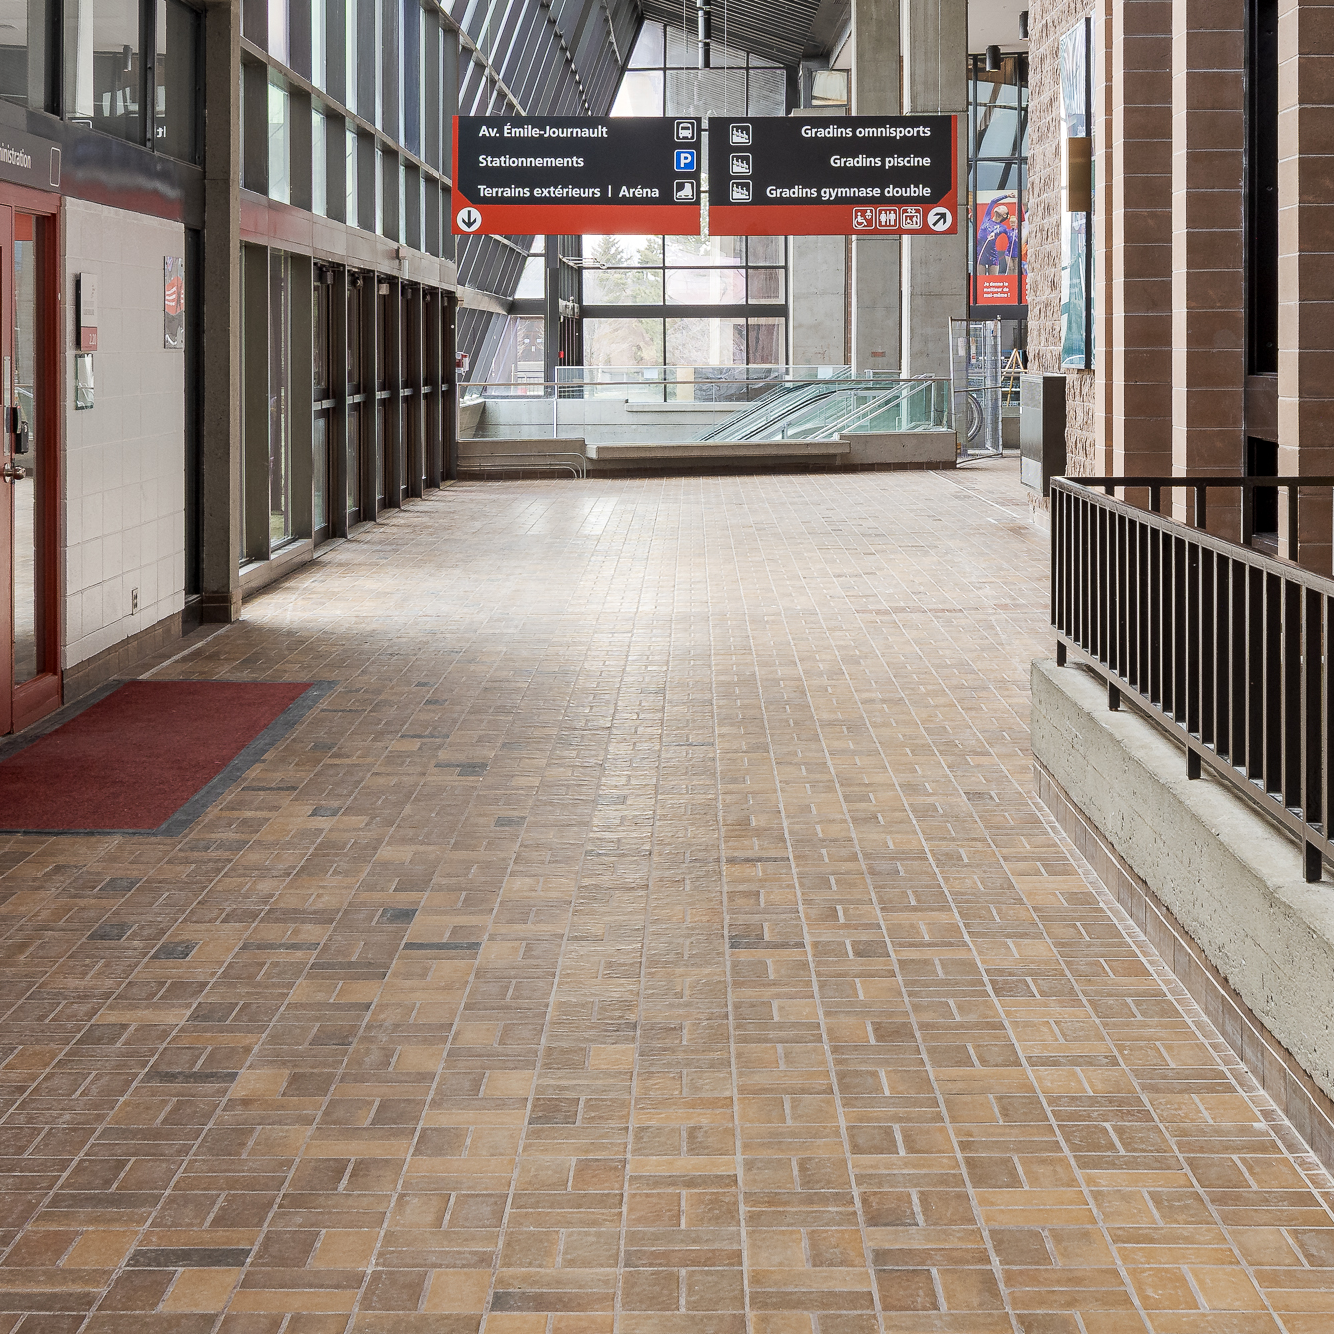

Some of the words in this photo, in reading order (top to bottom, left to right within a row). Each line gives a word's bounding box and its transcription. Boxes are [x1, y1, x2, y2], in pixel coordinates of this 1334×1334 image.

[478, 125, 500, 137] Av.
[503, 123, 608, 138] Émile-Journault
[801, 125, 852, 138] Gradins
[855, 124, 931, 140] omnisports
[478, 155, 585, 167] Stationnements
[830, 154, 882, 167] Gradins
[885, 154, 931, 169] piscine
[478, 185, 530, 197] Terrains
[533, 185, 601, 197] extérieurs
[618, 185, 660, 198] Aréna
[766, 185, 817, 198] Gradins
[820, 187, 881, 201] gymnase
[884, 184, 931, 197] double
